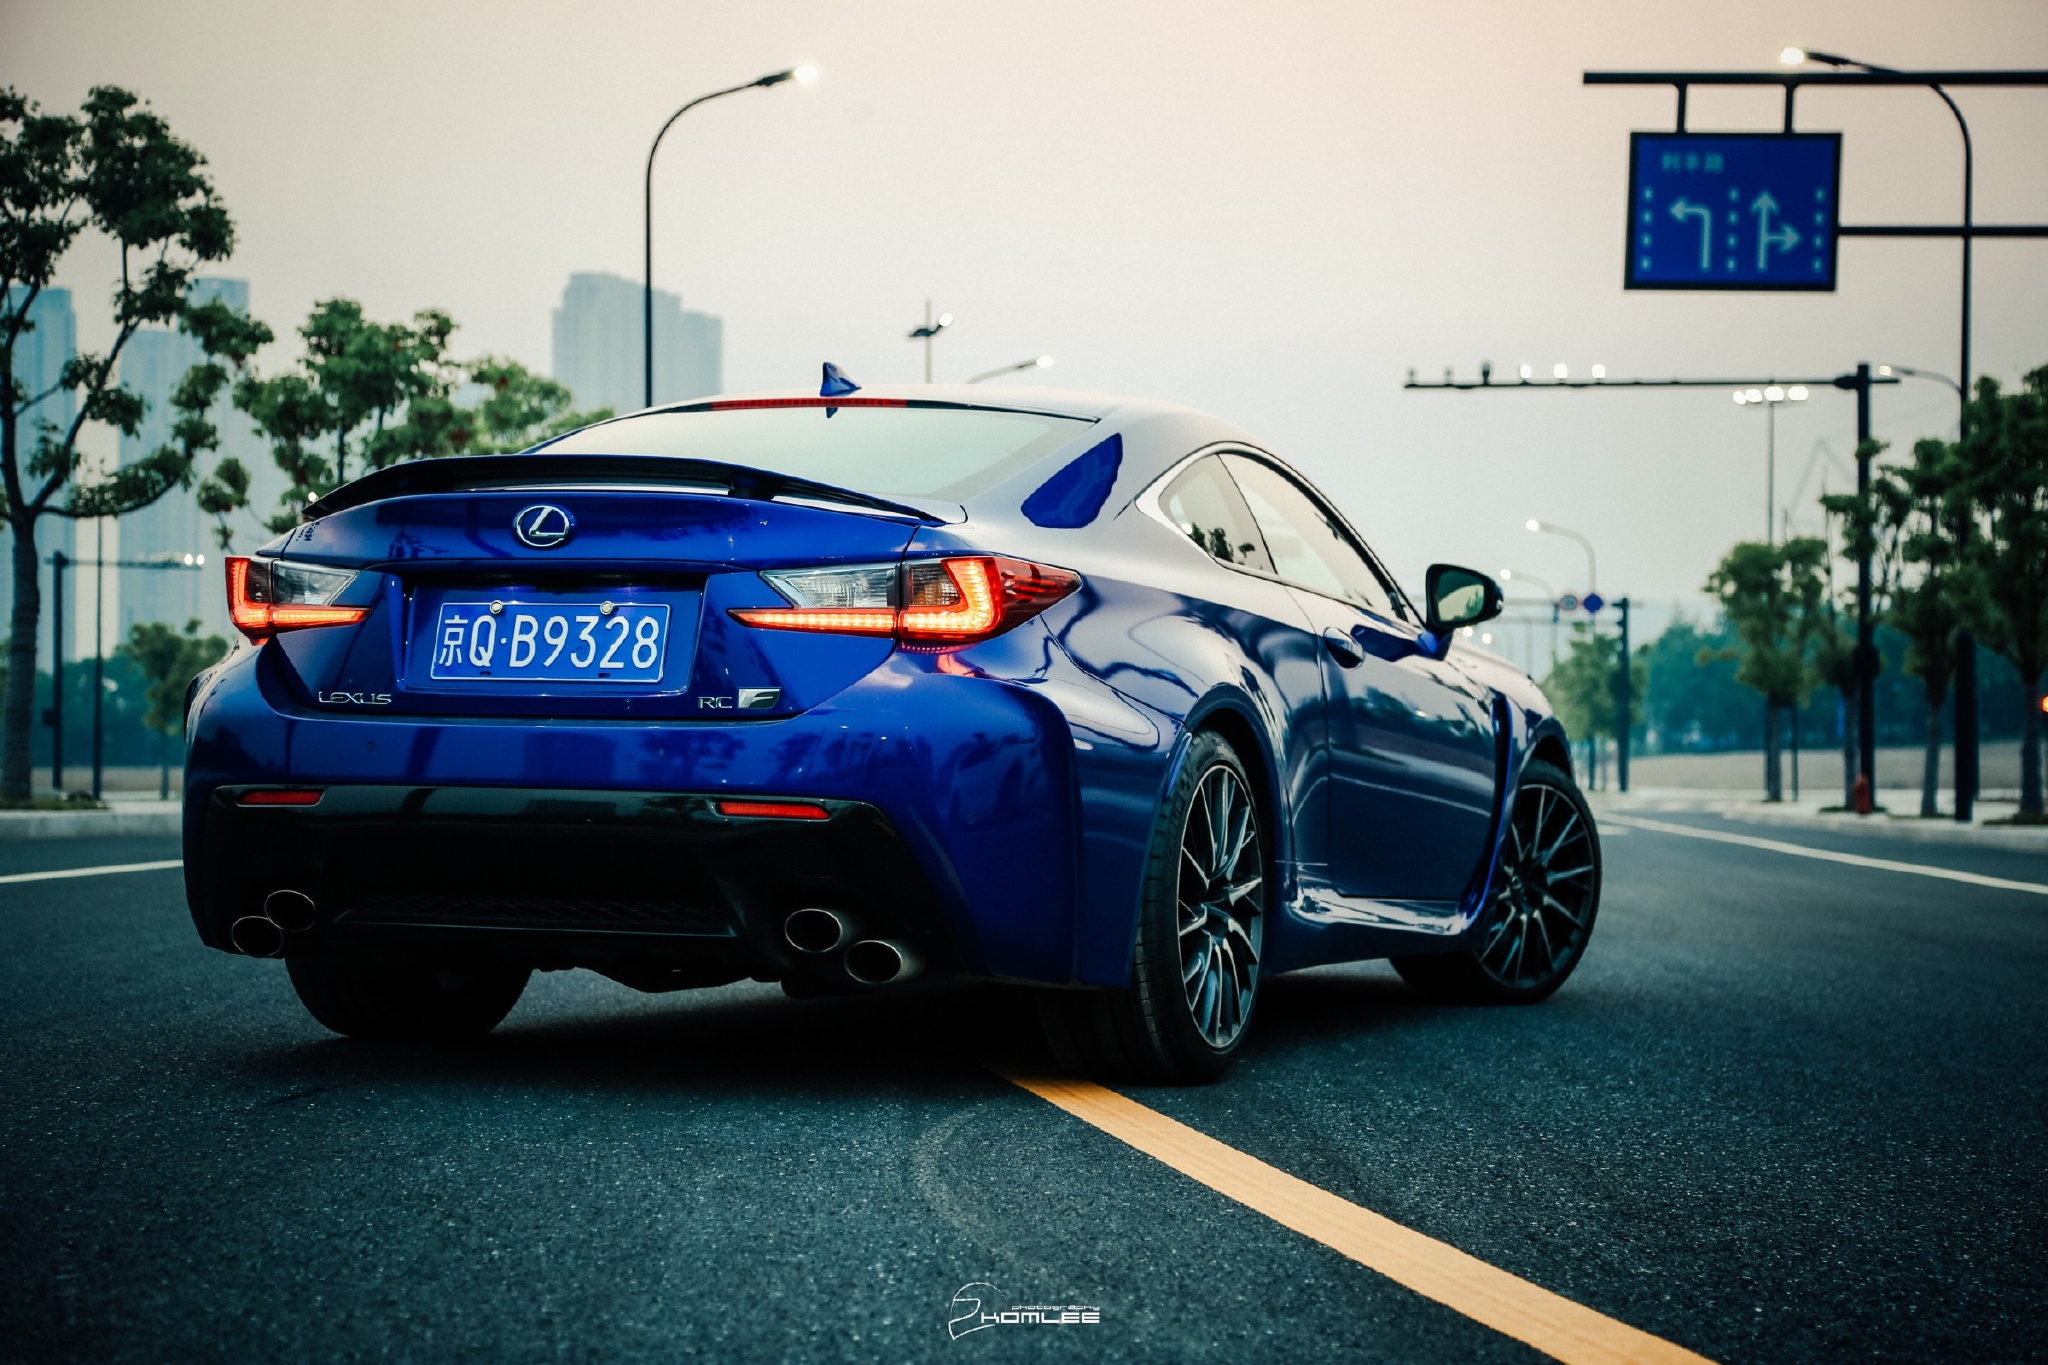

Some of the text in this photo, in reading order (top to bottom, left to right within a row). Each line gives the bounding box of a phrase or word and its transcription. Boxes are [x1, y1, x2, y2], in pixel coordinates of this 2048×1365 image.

[318, 691, 392, 705] LEXUS
[698, 688, 780, 709] RC F
